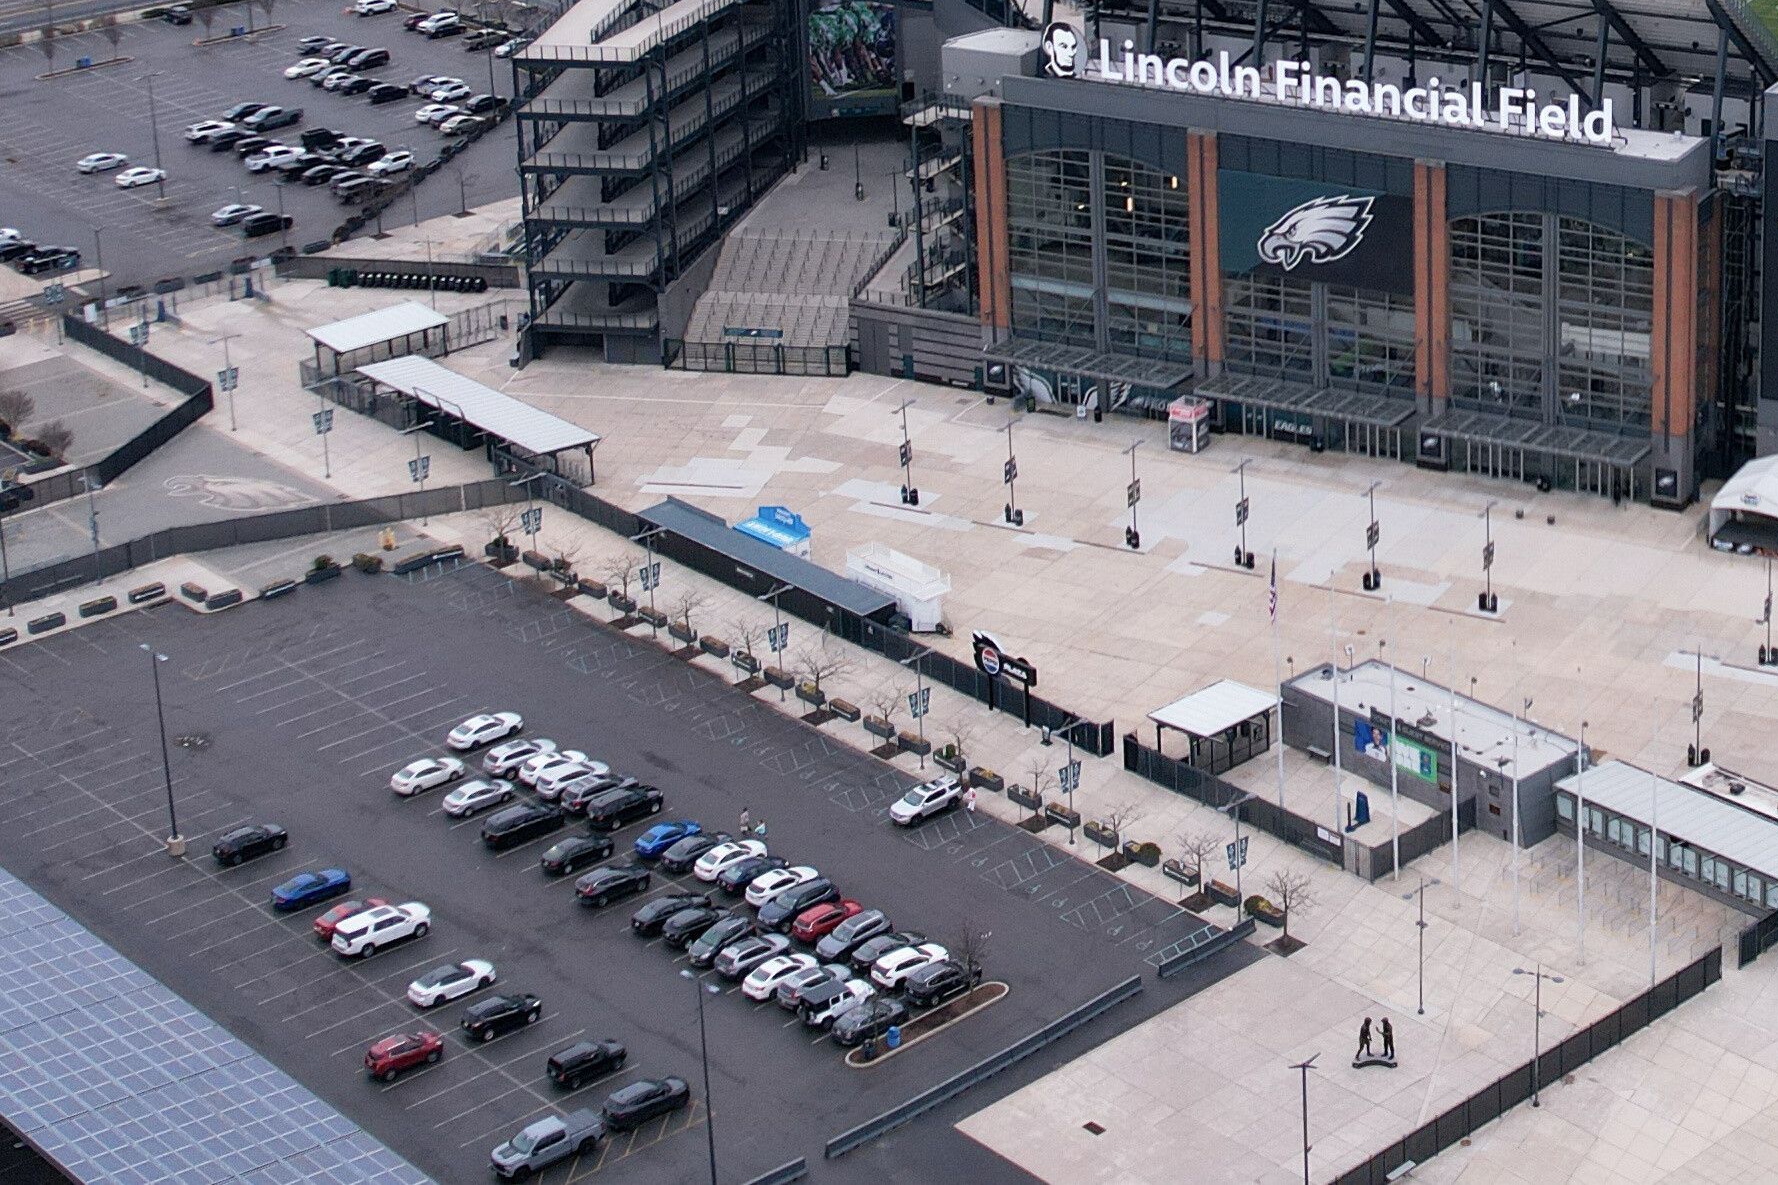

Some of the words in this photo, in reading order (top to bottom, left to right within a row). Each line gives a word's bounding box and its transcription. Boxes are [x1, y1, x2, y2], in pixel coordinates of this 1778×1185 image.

[1100, 38, 1261, 98] Lincoln
[1275, 59, 1485, 128] Financial
[1499, 87, 1613, 144] Field
[1273, 420, 1313, 435] EAGLES
